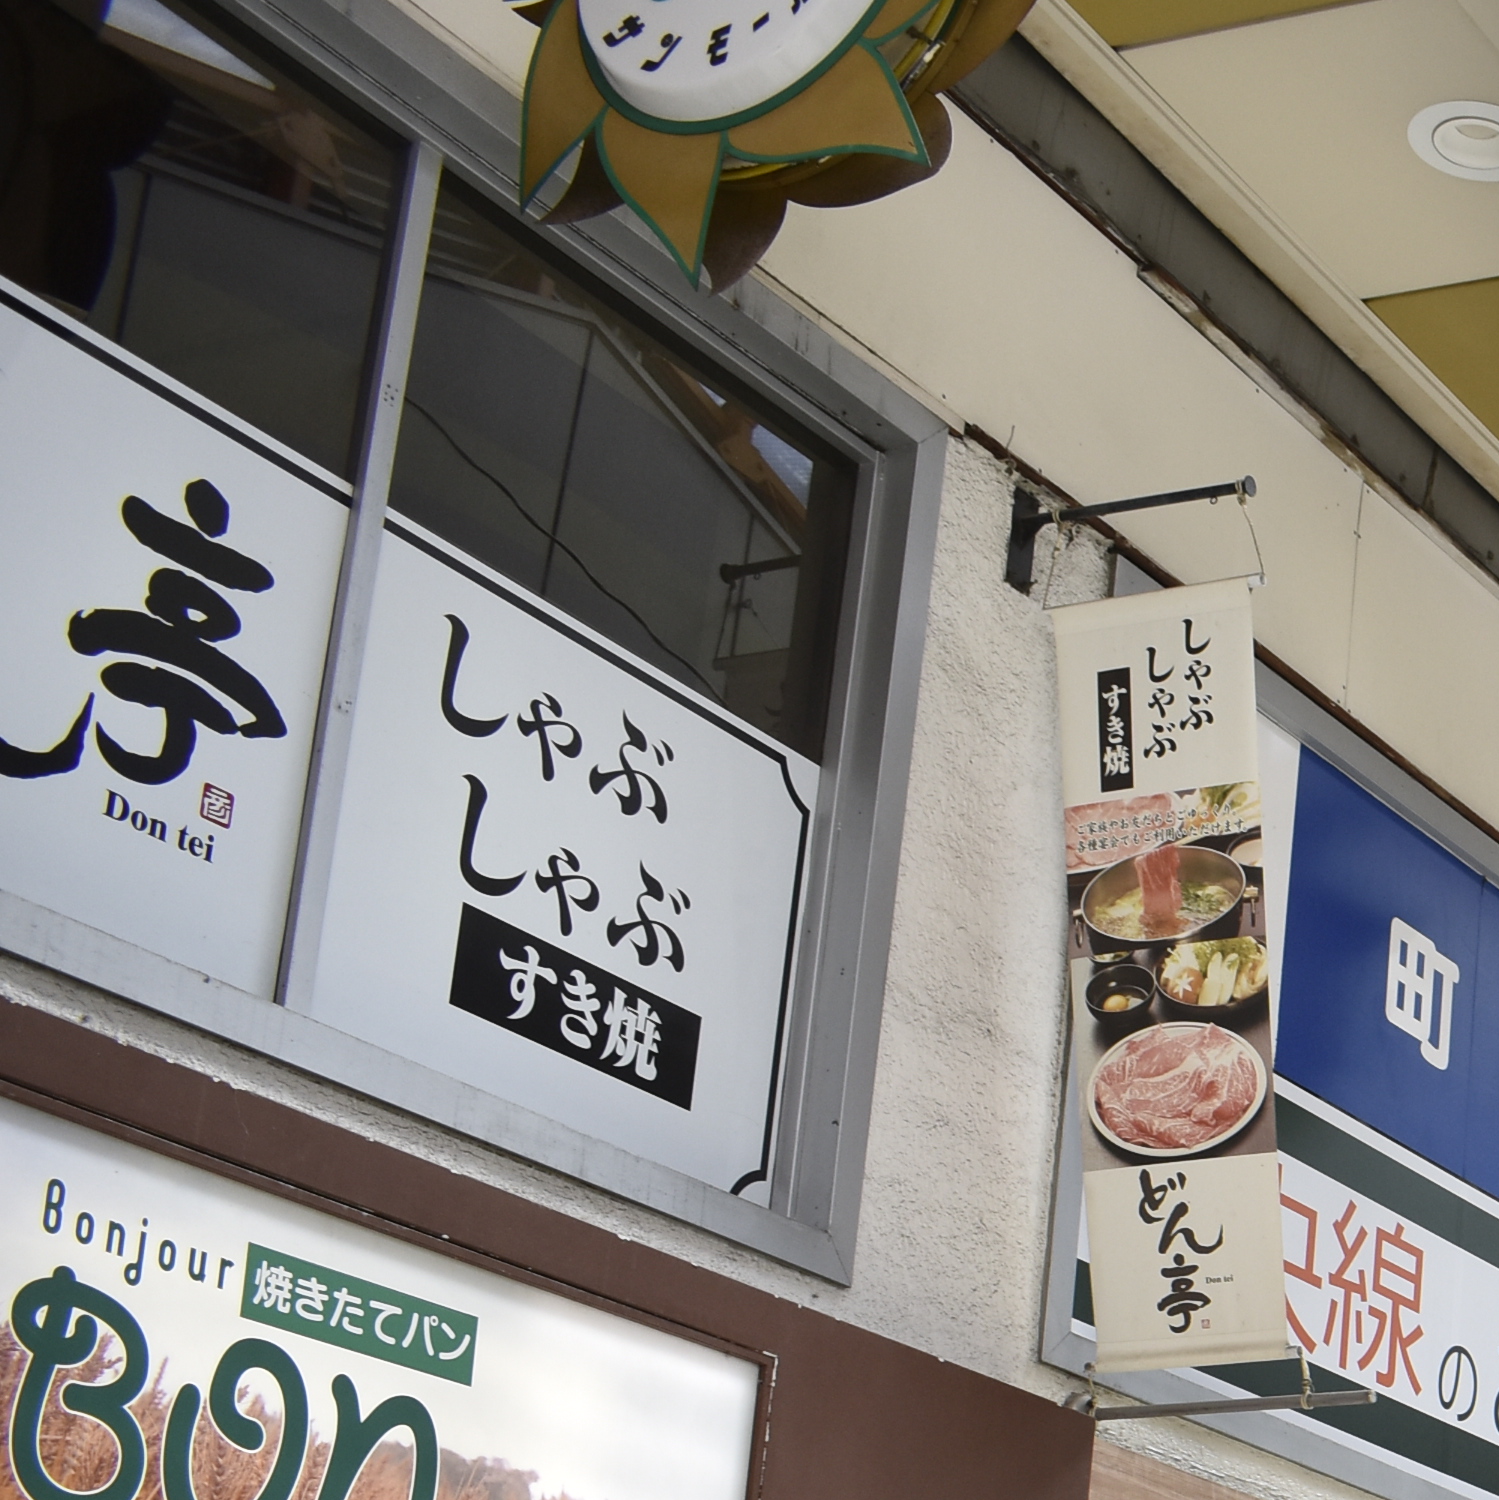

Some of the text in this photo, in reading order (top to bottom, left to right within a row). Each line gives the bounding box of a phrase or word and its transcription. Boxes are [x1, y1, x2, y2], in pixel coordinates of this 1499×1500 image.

[0, 478, 288, 785] 亭
[1180, 619, 1214, 731] しゃぶ
[441, 614, 674, 825] しゃぶ
[1101, 684, 1131, 776] すき焼
[1143, 647, 1177, 759] しゃぶ
[102, 787, 169, 842] Don
[176, 826, 216, 864] tei
[459, 774, 693, 973] しゃぶ
[499, 946, 663, 1083] すき焼
[42, 1178, 235, 1288] Bonjour
[1139, 1169, 1224, 1333] どん亭
[1206, 1273, 1234, 1285] Don tei
[252, 1260, 472, 1364] 焼きたてパン
